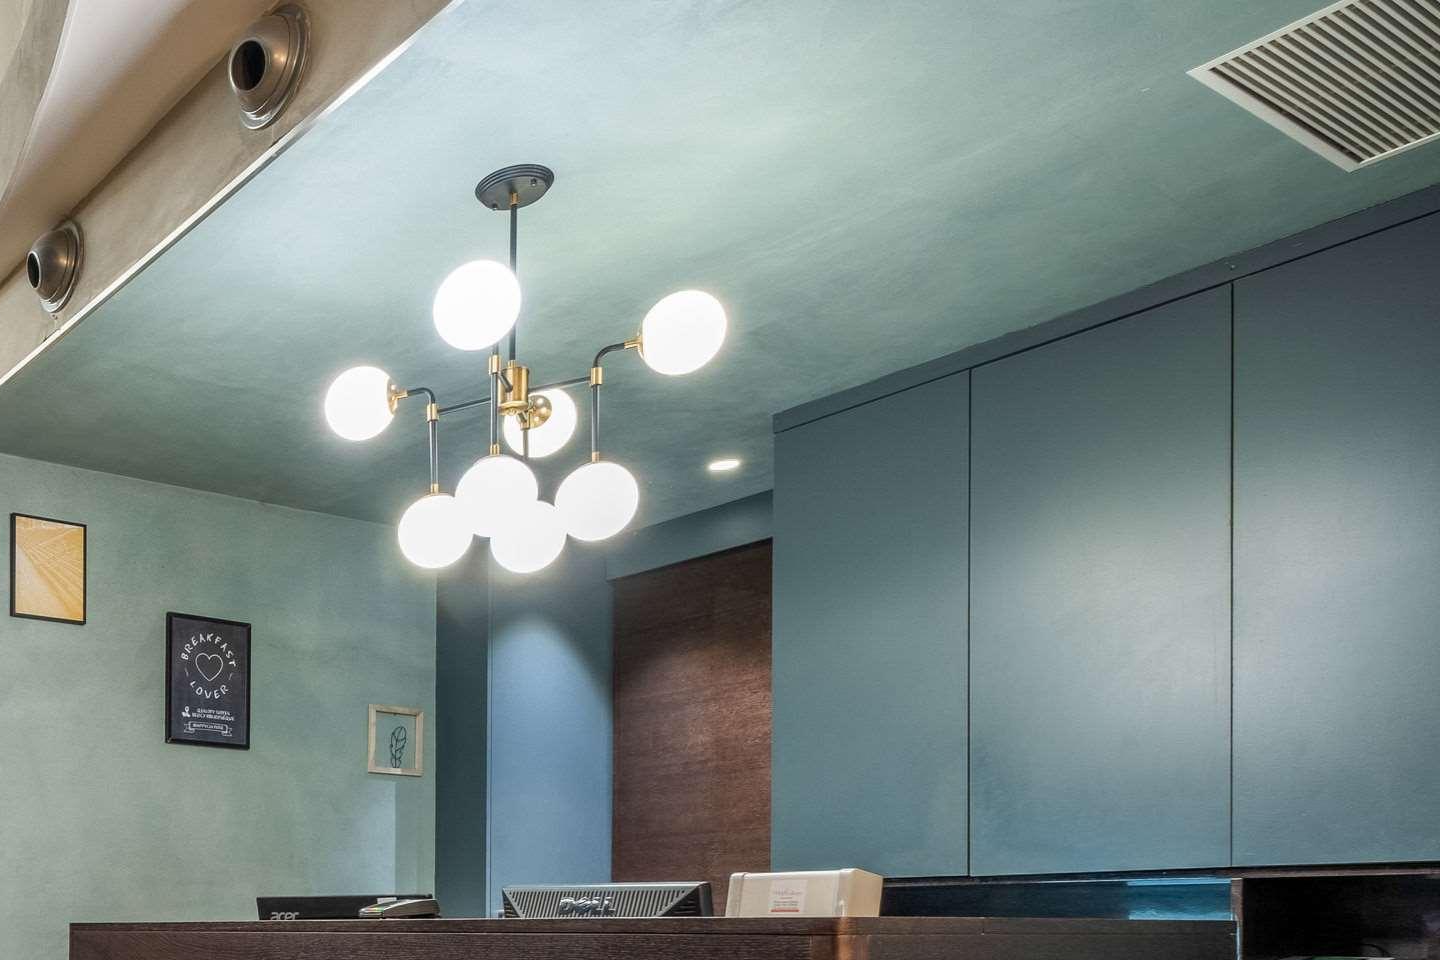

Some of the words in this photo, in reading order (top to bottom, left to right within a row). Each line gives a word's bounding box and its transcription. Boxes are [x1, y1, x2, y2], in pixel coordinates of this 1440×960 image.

[180, 633, 237, 668] BREAKFAST
[190, 680, 229, 700] LOVER
[559, 896, 616, 914] DELL
[270, 911, 300, 920] acer
